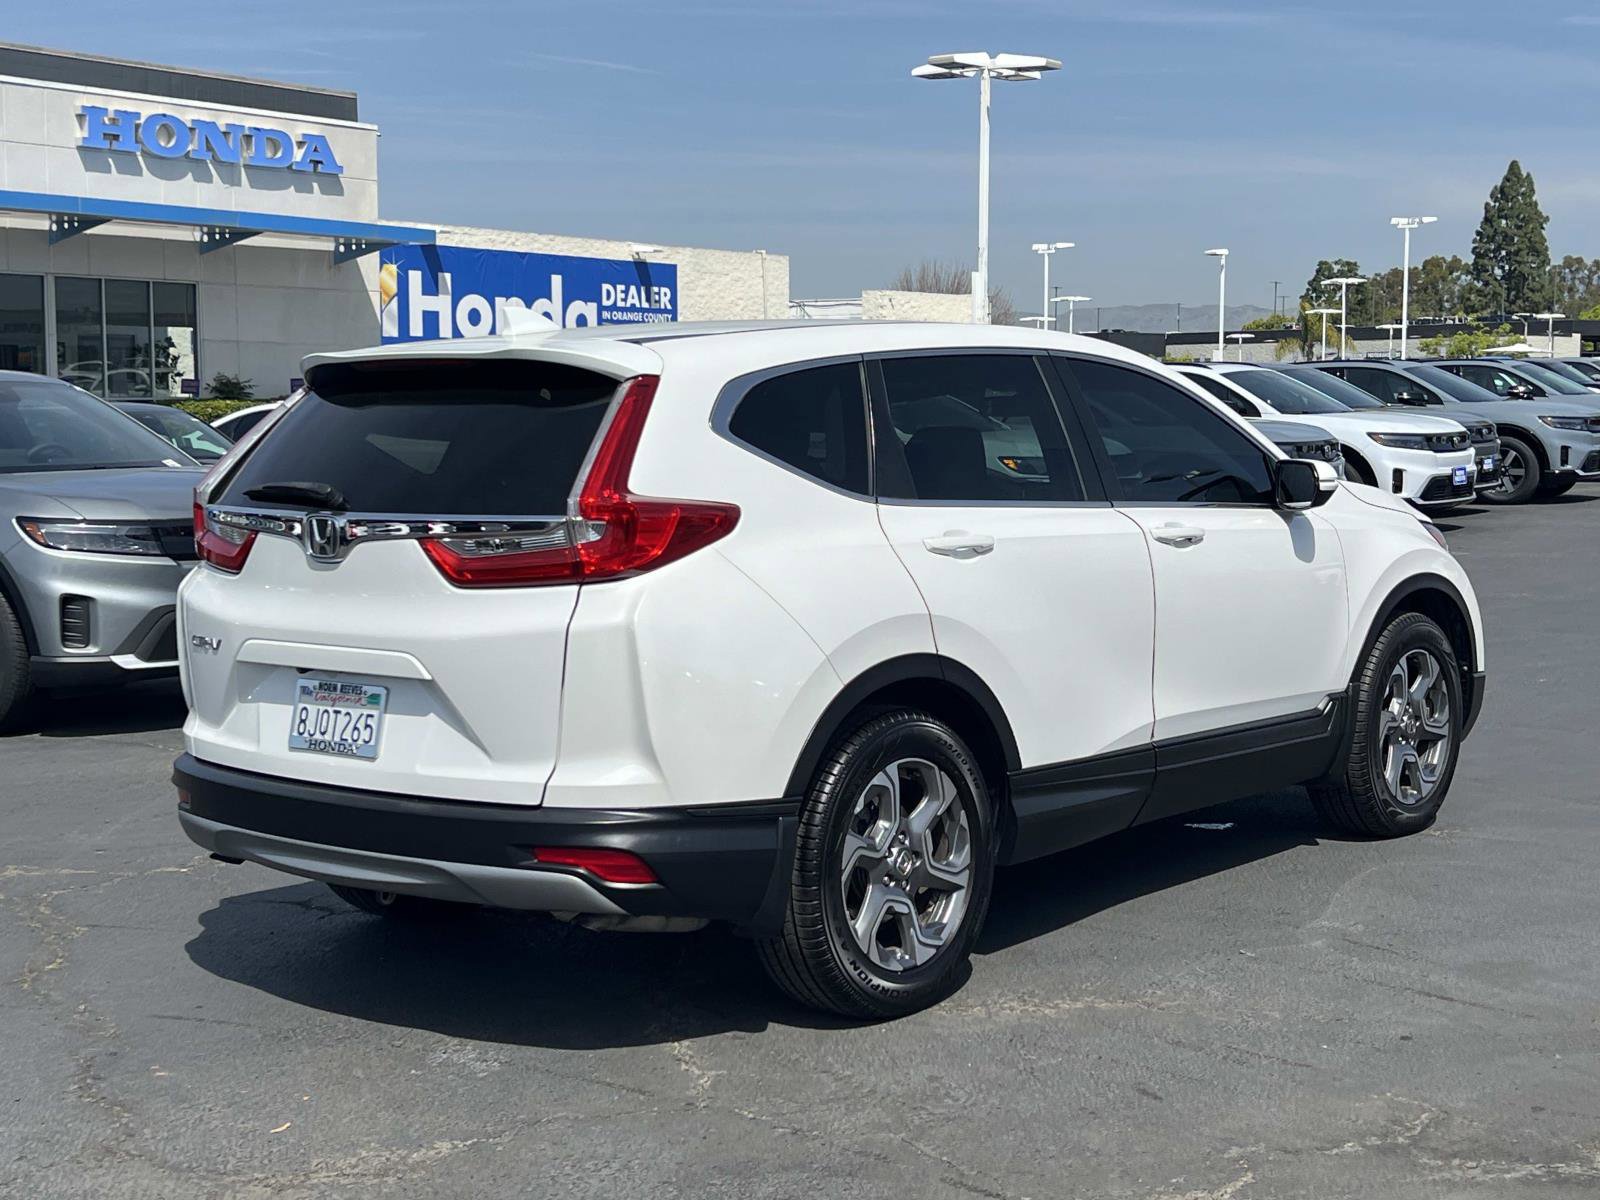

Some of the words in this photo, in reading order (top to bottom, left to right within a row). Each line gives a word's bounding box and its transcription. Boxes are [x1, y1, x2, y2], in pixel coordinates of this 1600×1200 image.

[78, 105, 344, 174] HONDA
[601, 283, 673, 310] DEALER
[602, 310, 611, 320] IN
[611, 311, 643, 322] ORANGE
[643, 313, 673, 324] COUNTY
[307, 738, 359, 755] HONDA
